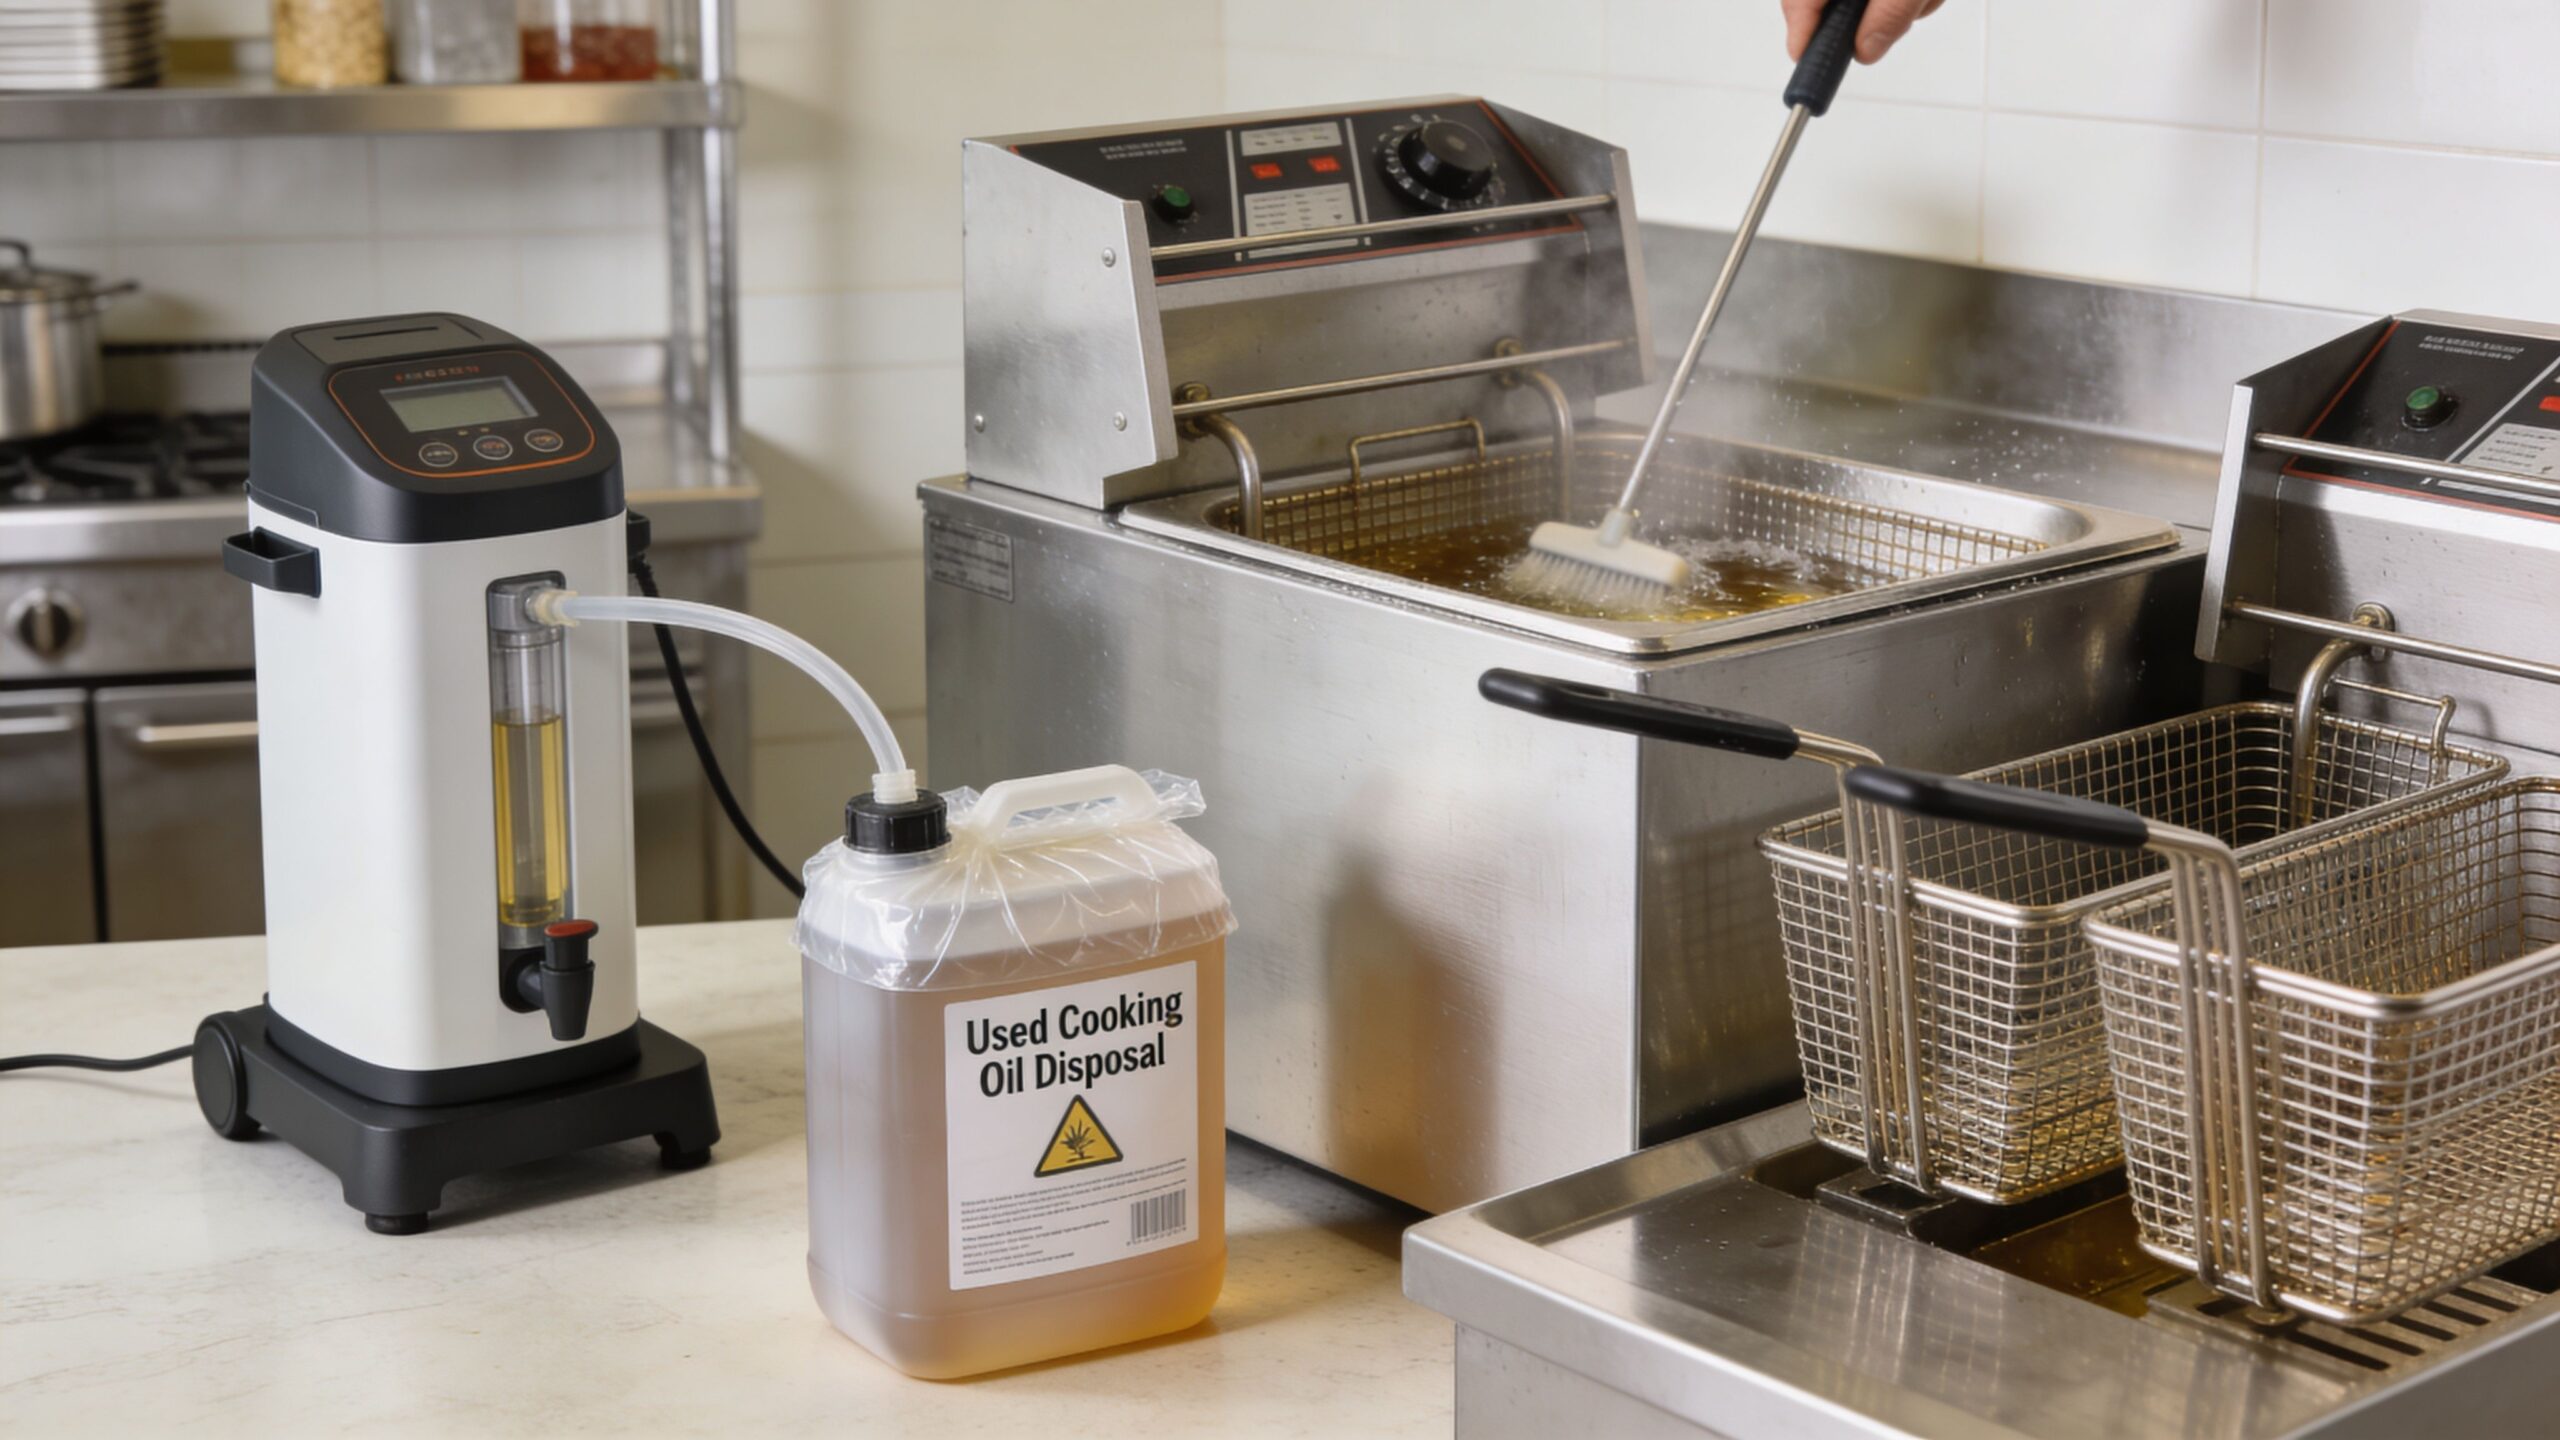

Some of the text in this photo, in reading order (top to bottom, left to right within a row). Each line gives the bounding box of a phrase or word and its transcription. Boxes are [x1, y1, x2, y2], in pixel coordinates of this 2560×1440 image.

[967, 992, 1183, 1055] Used Cooking
[980, 1032, 1165, 1097] Oil Disposal
